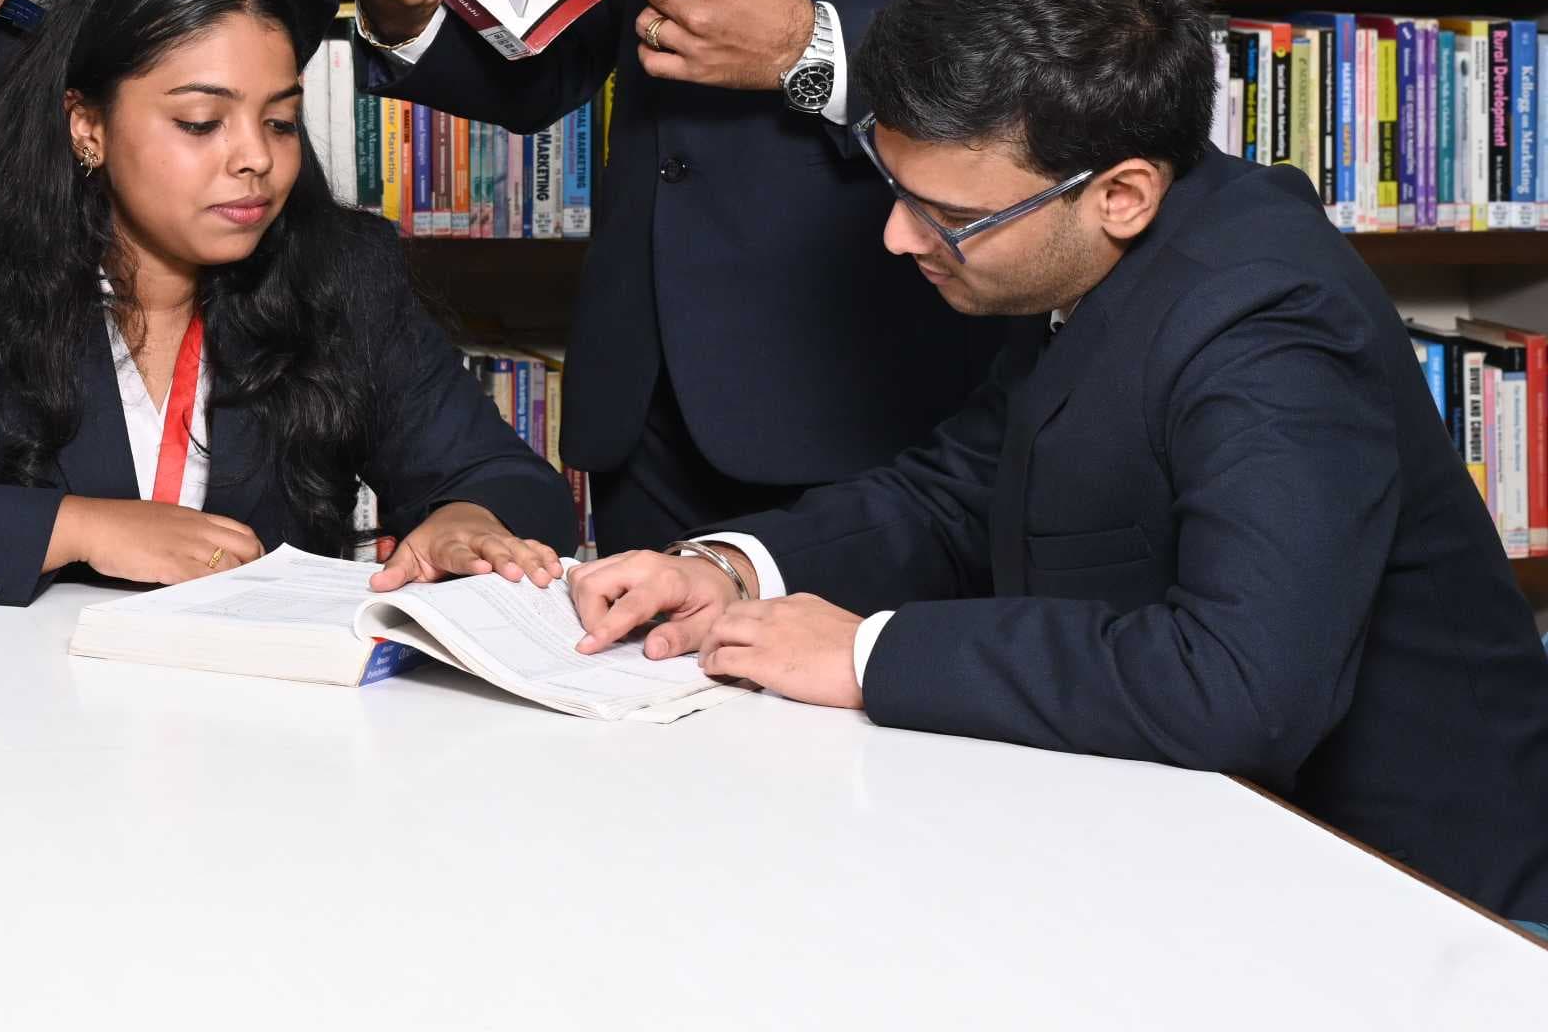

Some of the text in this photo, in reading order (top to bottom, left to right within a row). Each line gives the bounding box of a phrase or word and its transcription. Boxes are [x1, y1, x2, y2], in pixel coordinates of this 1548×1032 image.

[1491, 30, 1507, 146] Rural Development
[387, 132, 396, 183] Marketing
[576, 132, 587, 189] MARKETING
[1517, 66, 1533, 193] Kellogg on Marketing
[537, 134, 552, 201] MARKETING
[517, 369, 527, 426] Marketing the
[1468, 367, 1482, 462] DIVIDE AND CONQUER
